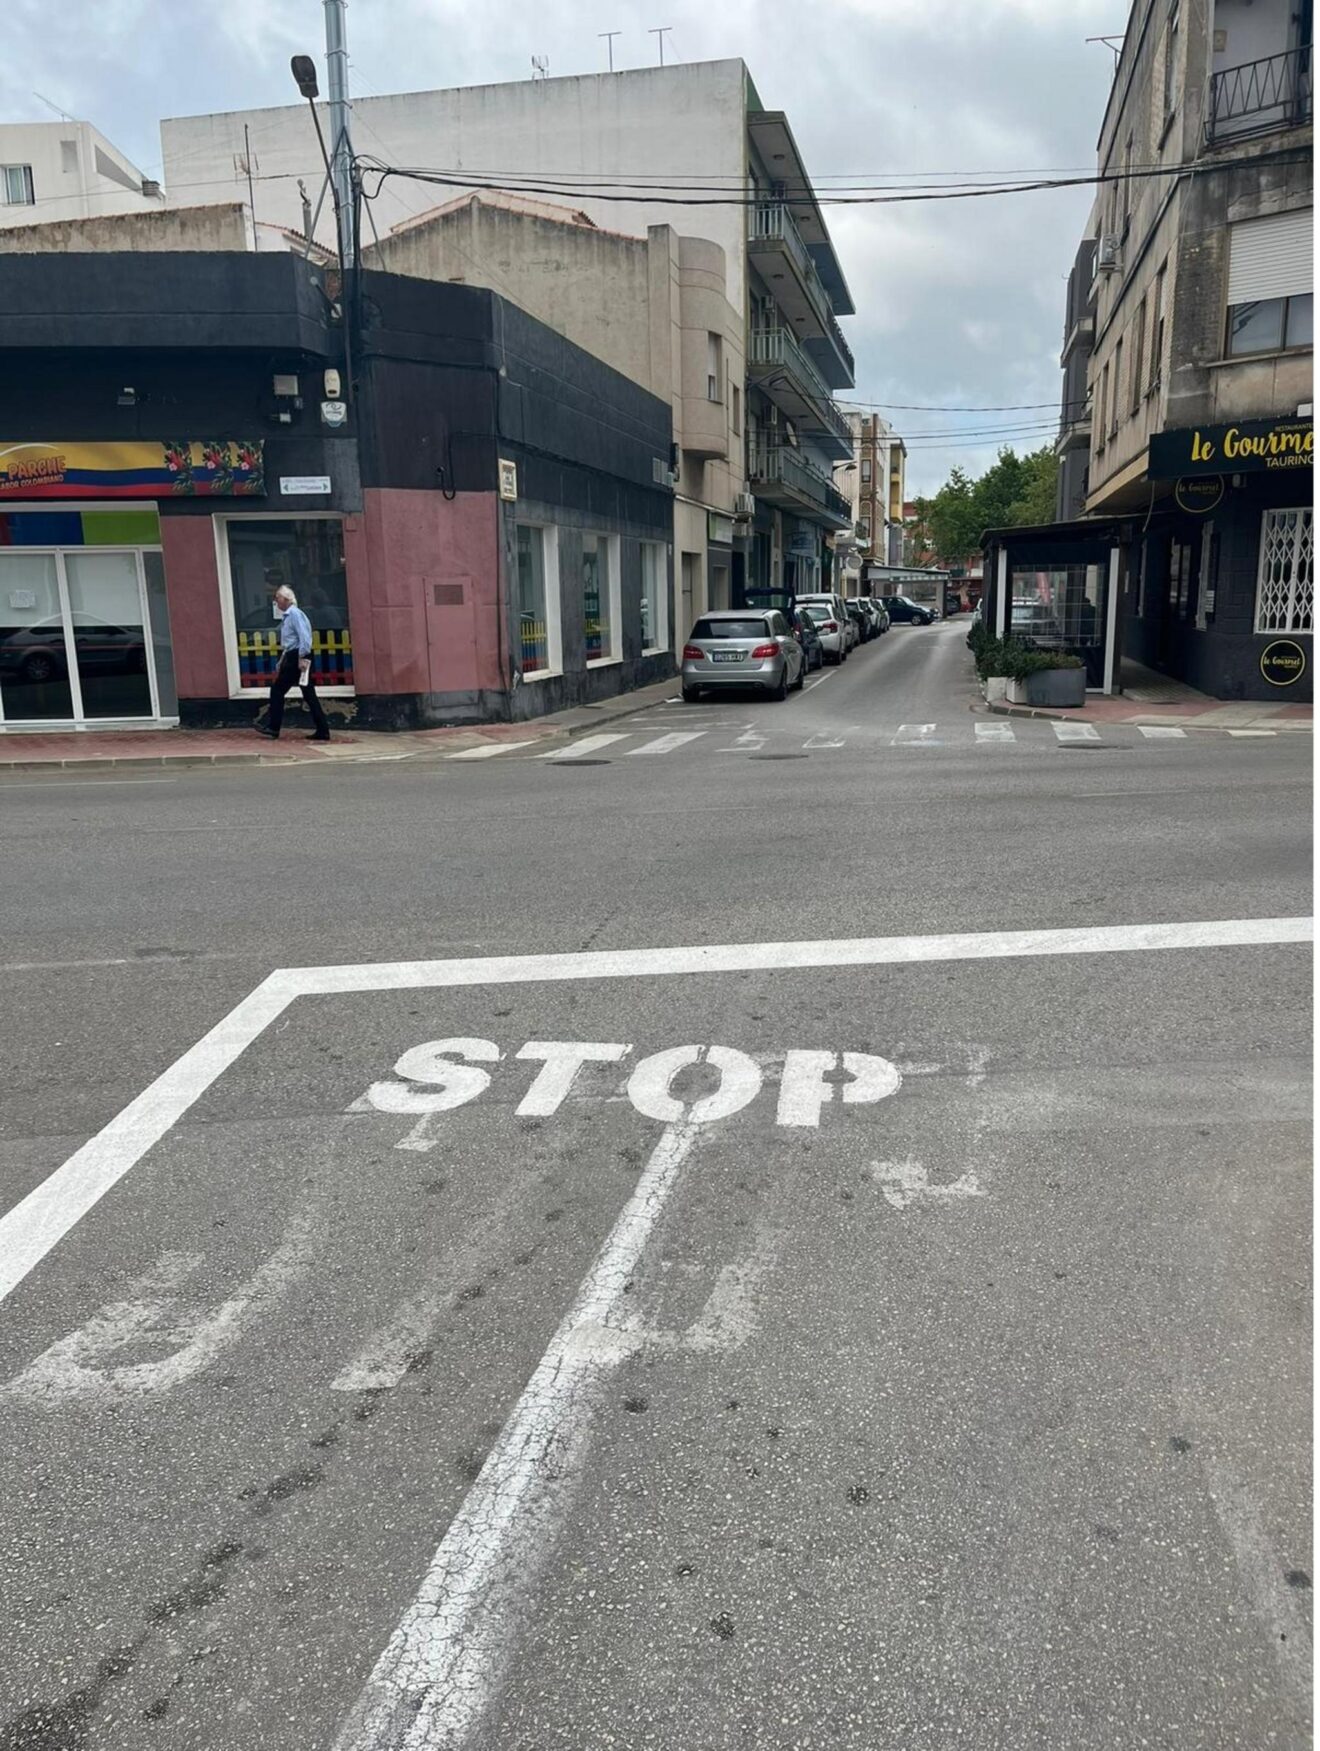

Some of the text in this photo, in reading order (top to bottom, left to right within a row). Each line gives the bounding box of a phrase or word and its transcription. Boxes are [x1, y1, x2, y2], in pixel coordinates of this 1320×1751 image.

[1191, 431, 1215, 461] Le
[7, 455, 67, 480] PARCHE
[20, 474, 64, 487] COLOMBIANO
[365, 1037, 902, 1127] STOP
